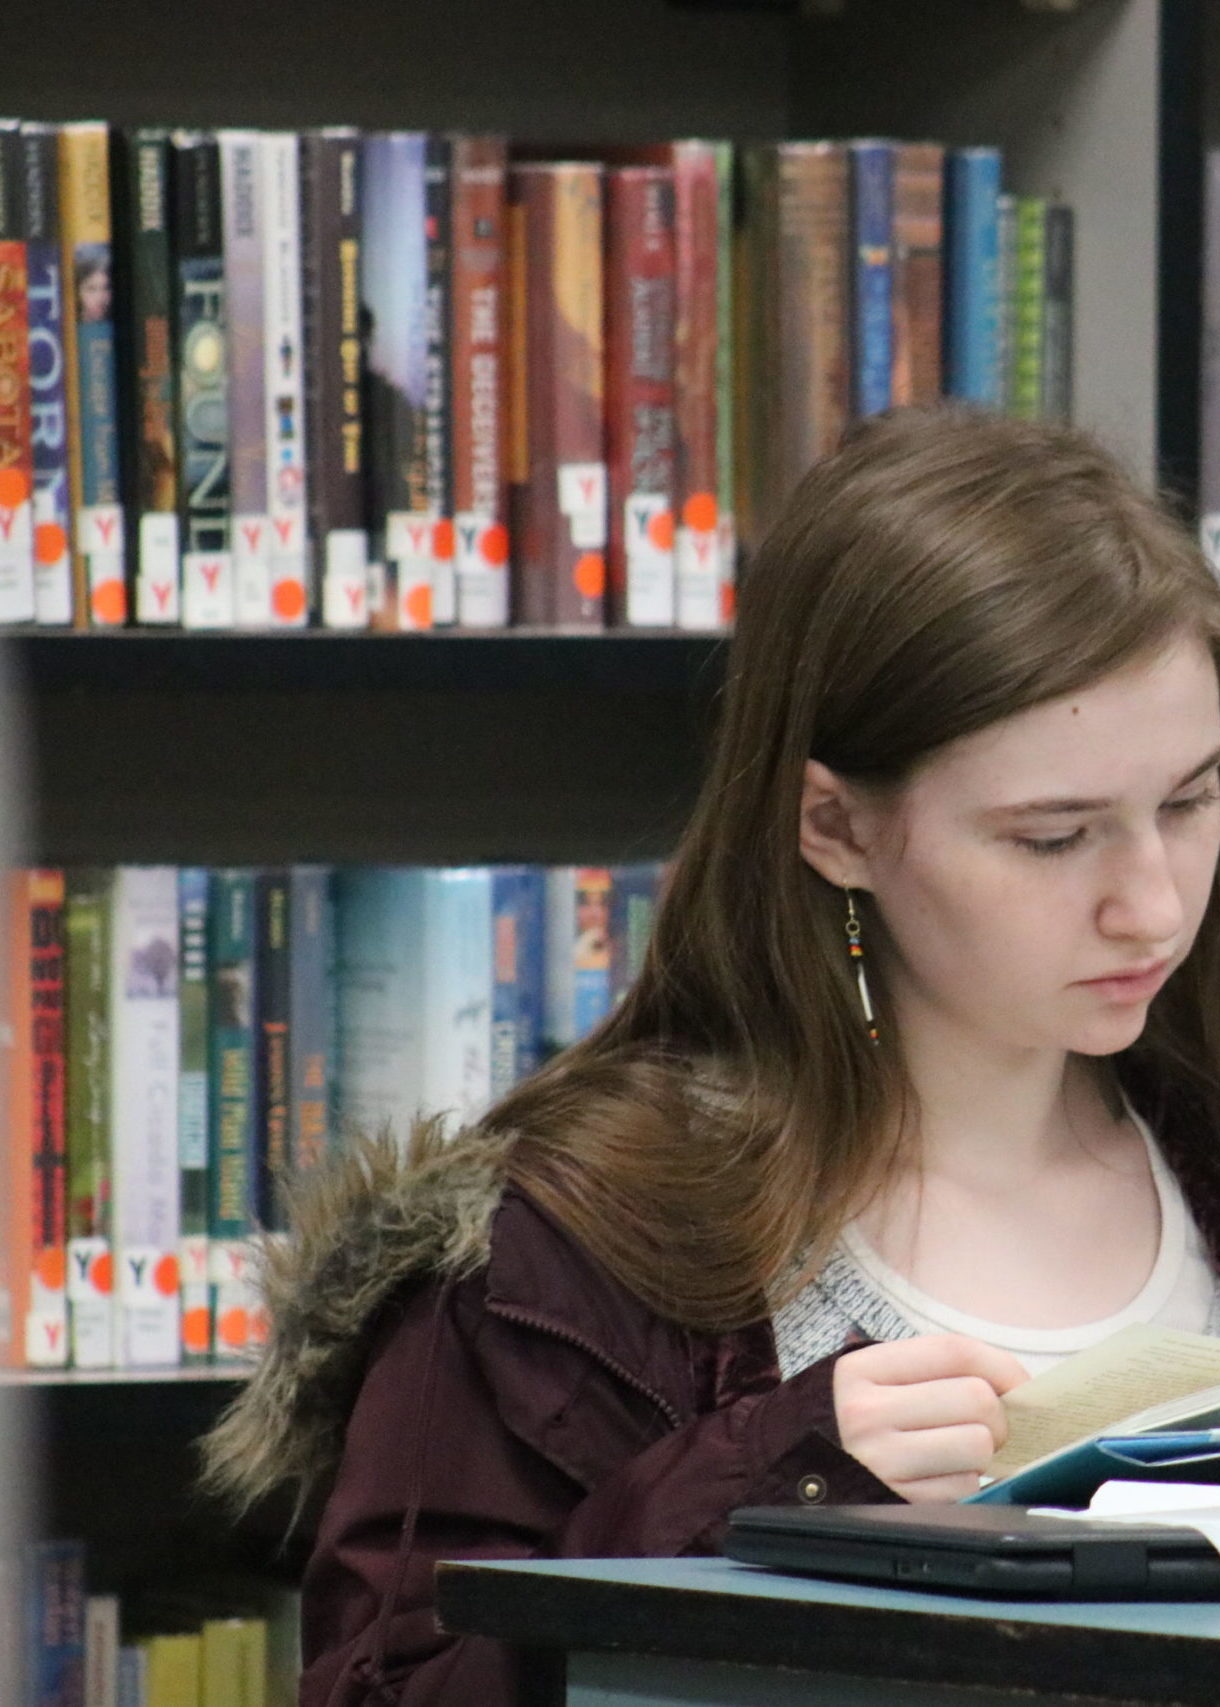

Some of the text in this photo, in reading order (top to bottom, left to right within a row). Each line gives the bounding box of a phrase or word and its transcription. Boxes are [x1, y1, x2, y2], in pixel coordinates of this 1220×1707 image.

[470, 288, 497, 343] THE
[185, 278, 227, 552] FOUND
[580, 477, 597, 503] Y
[95, 515, 115, 546] Y
[242, 524, 262, 553] Y
[274, 518, 293, 545] Y
[409, 524, 425, 553] Y
[460, 518, 477, 547] Y
[634, 511, 649, 538] Y
[693, 534, 713, 565] Y
[201, 563, 221, 594] Y
[152, 583, 172, 614] Y
[345, 586, 365, 614] Y
[75, 1251, 89, 1285] Y
[129, 1258, 146, 1288] Y
[188, 1246, 207, 1273] Y
[229, 1250, 245, 1278] Y
[44, 1322, 64, 1350] Y
